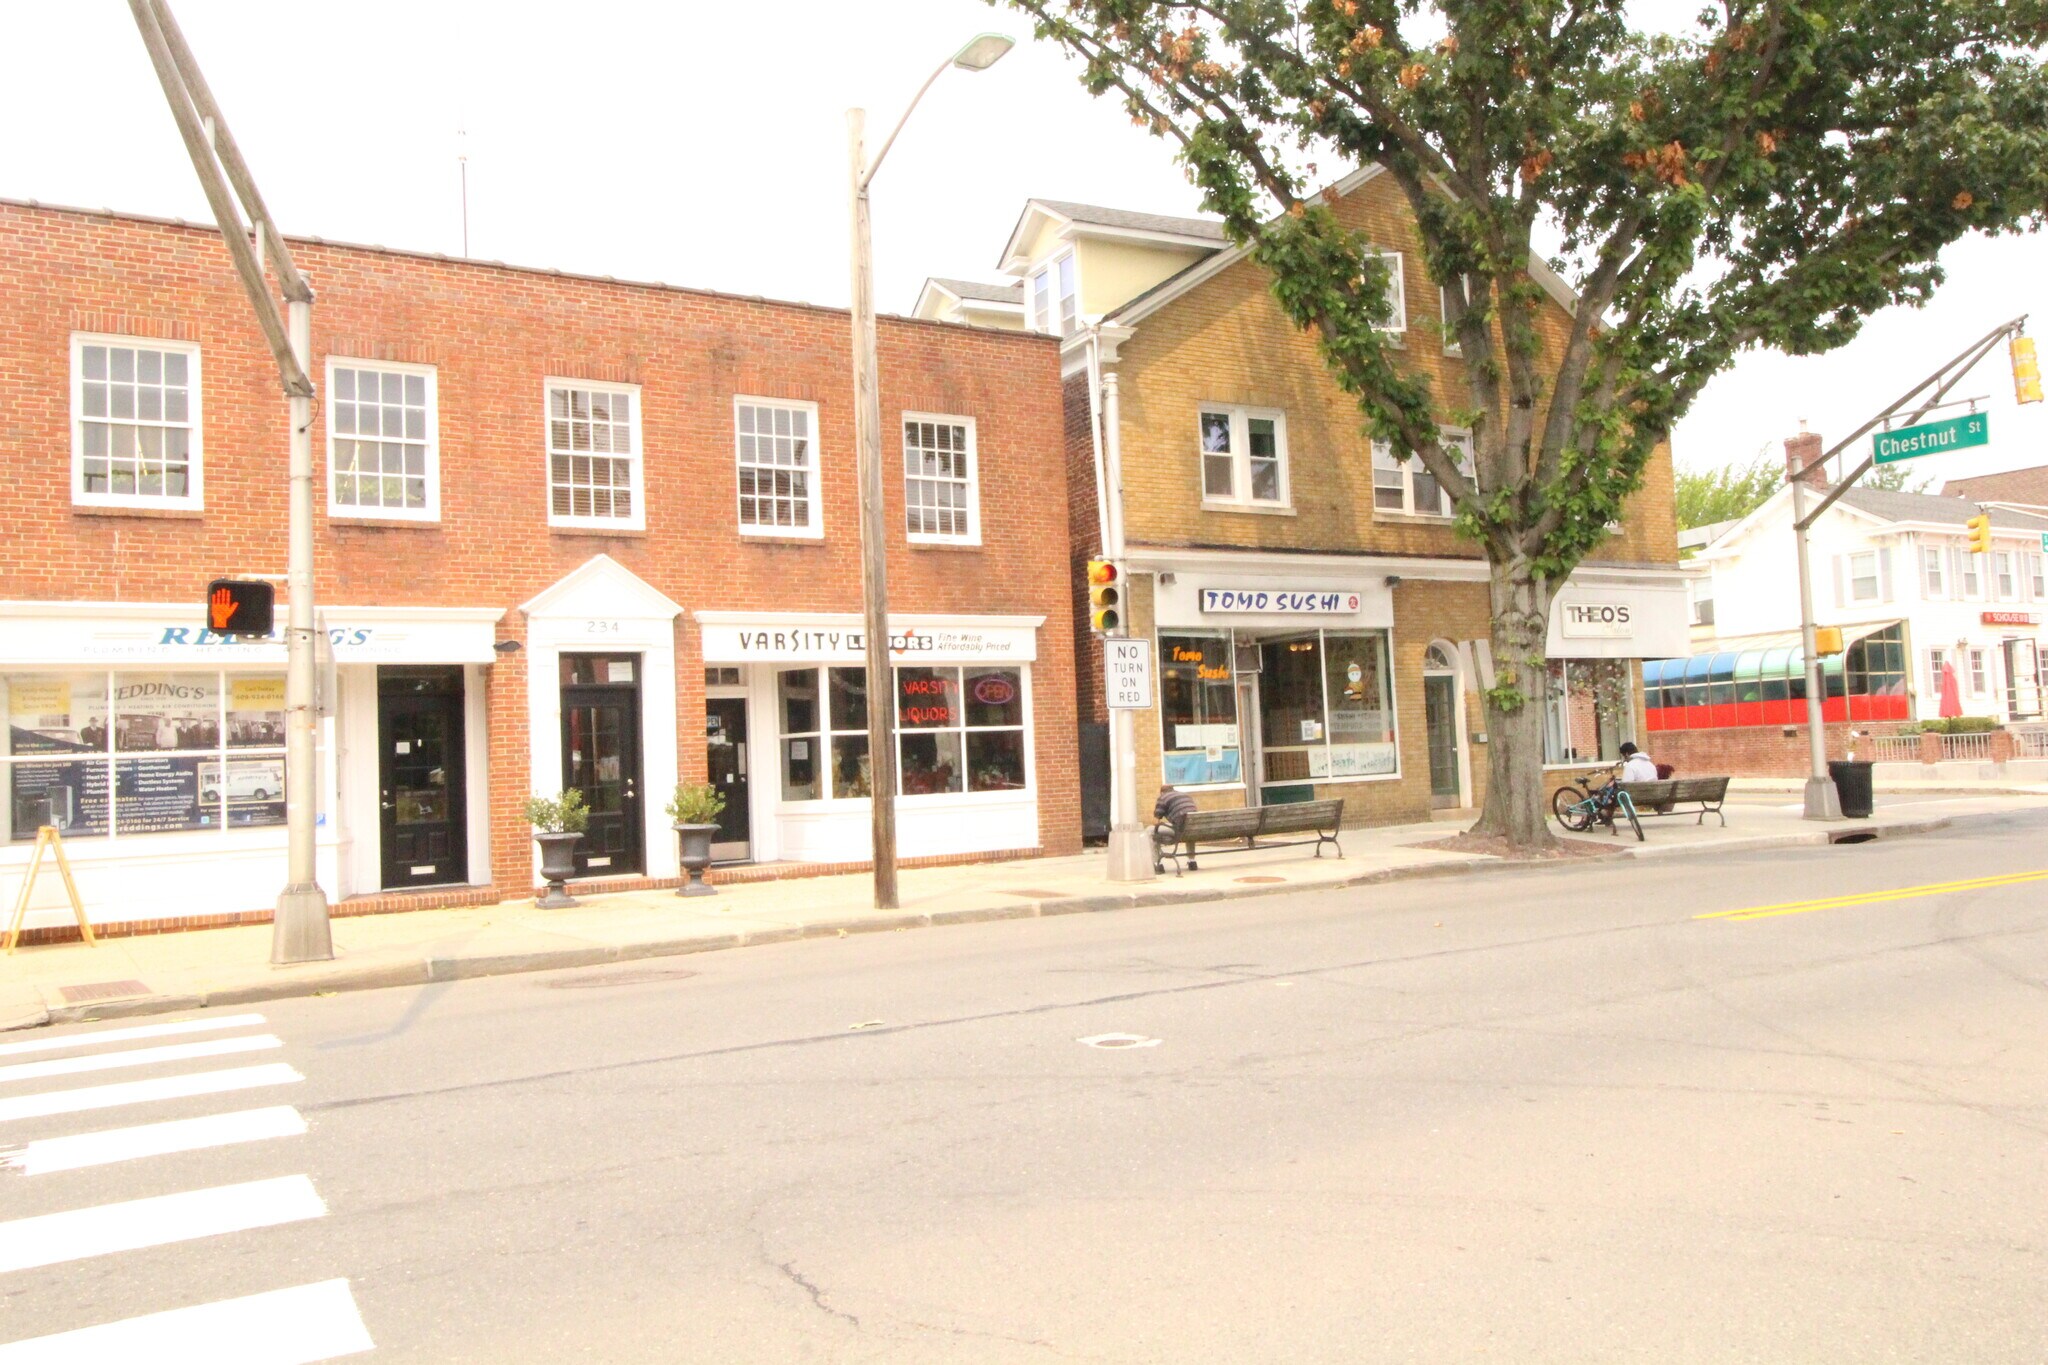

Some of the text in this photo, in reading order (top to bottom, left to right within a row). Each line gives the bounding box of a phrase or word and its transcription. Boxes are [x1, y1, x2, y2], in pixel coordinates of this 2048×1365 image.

[1880, 422, 1981, 456] Chestnut St
[1207, 592, 1341, 611] TOMO SUSHI
[1566, 606, 1631, 623] THEO'S
[587, 621, 619, 633] 234
[740, 630, 932, 652] VARSITY LIORS
[938, 633, 983, 643] Fine Wine
[198, 646, 263, 654] HEATING
[937, 641, 1012, 654] Affordably Priced
[1118, 646, 1138, 659] NO
[1173, 647, 1202, 663] Tomo
[1114, 663, 1143, 673] TURN
[1198, 664, 1231, 681] Sushi
[904, 681, 959, 695] VARSITY
[1122, 677, 1136, 688] ON
[1119, 692, 1140, 702] RED
[899, 707, 957, 724] LIQUORS
